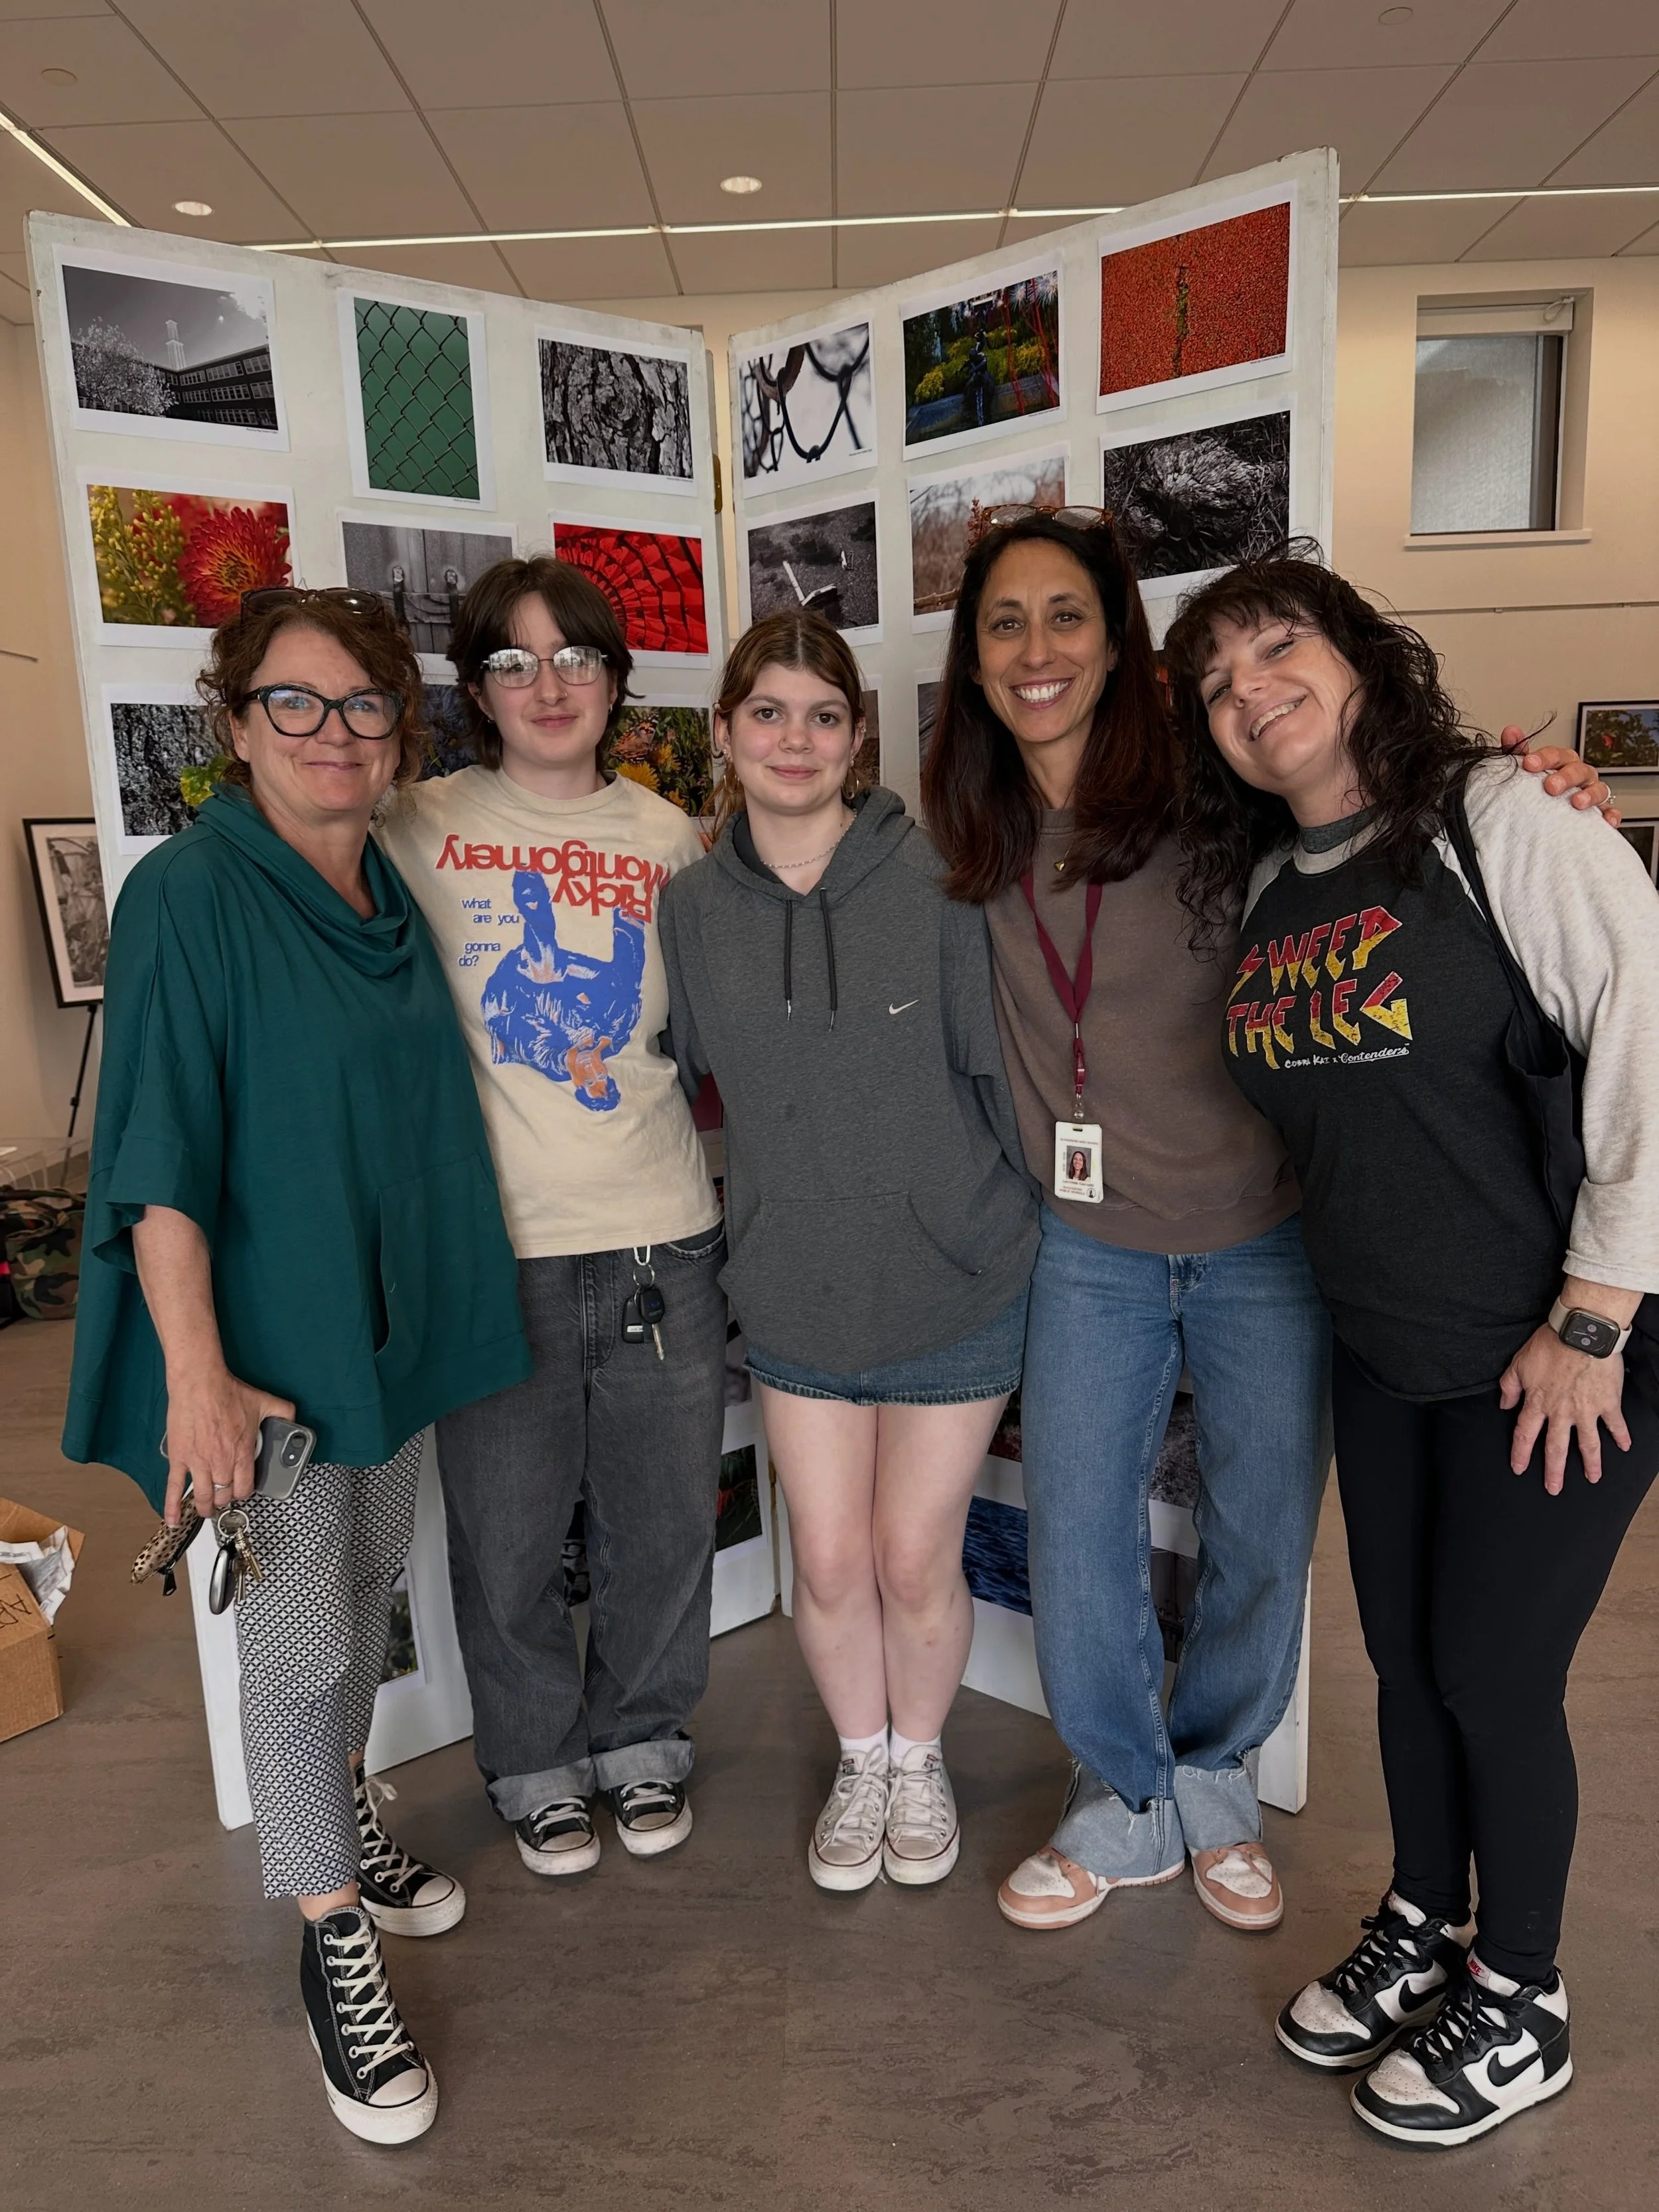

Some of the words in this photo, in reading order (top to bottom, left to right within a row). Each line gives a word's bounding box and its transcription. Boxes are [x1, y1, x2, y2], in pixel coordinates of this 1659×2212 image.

[435, 834, 670, 891] Montgomery
[461, 897, 492, 909] what
[552, 872, 651, 923] Ricky
[472, 914, 492, 923] are
[497, 914, 520, 926] you
[465, 942, 500, 954] gonna
[458, 955, 479, 966] do?
[1226, 905, 1403, 1009] SWEEP
[1226, 995, 1297, 1069] THE
[1309, 971, 1413, 1050] LEG
[1338, 1045, 1410, 1063] Contenders
[1469, 1958, 1482, 1974] NIKE
